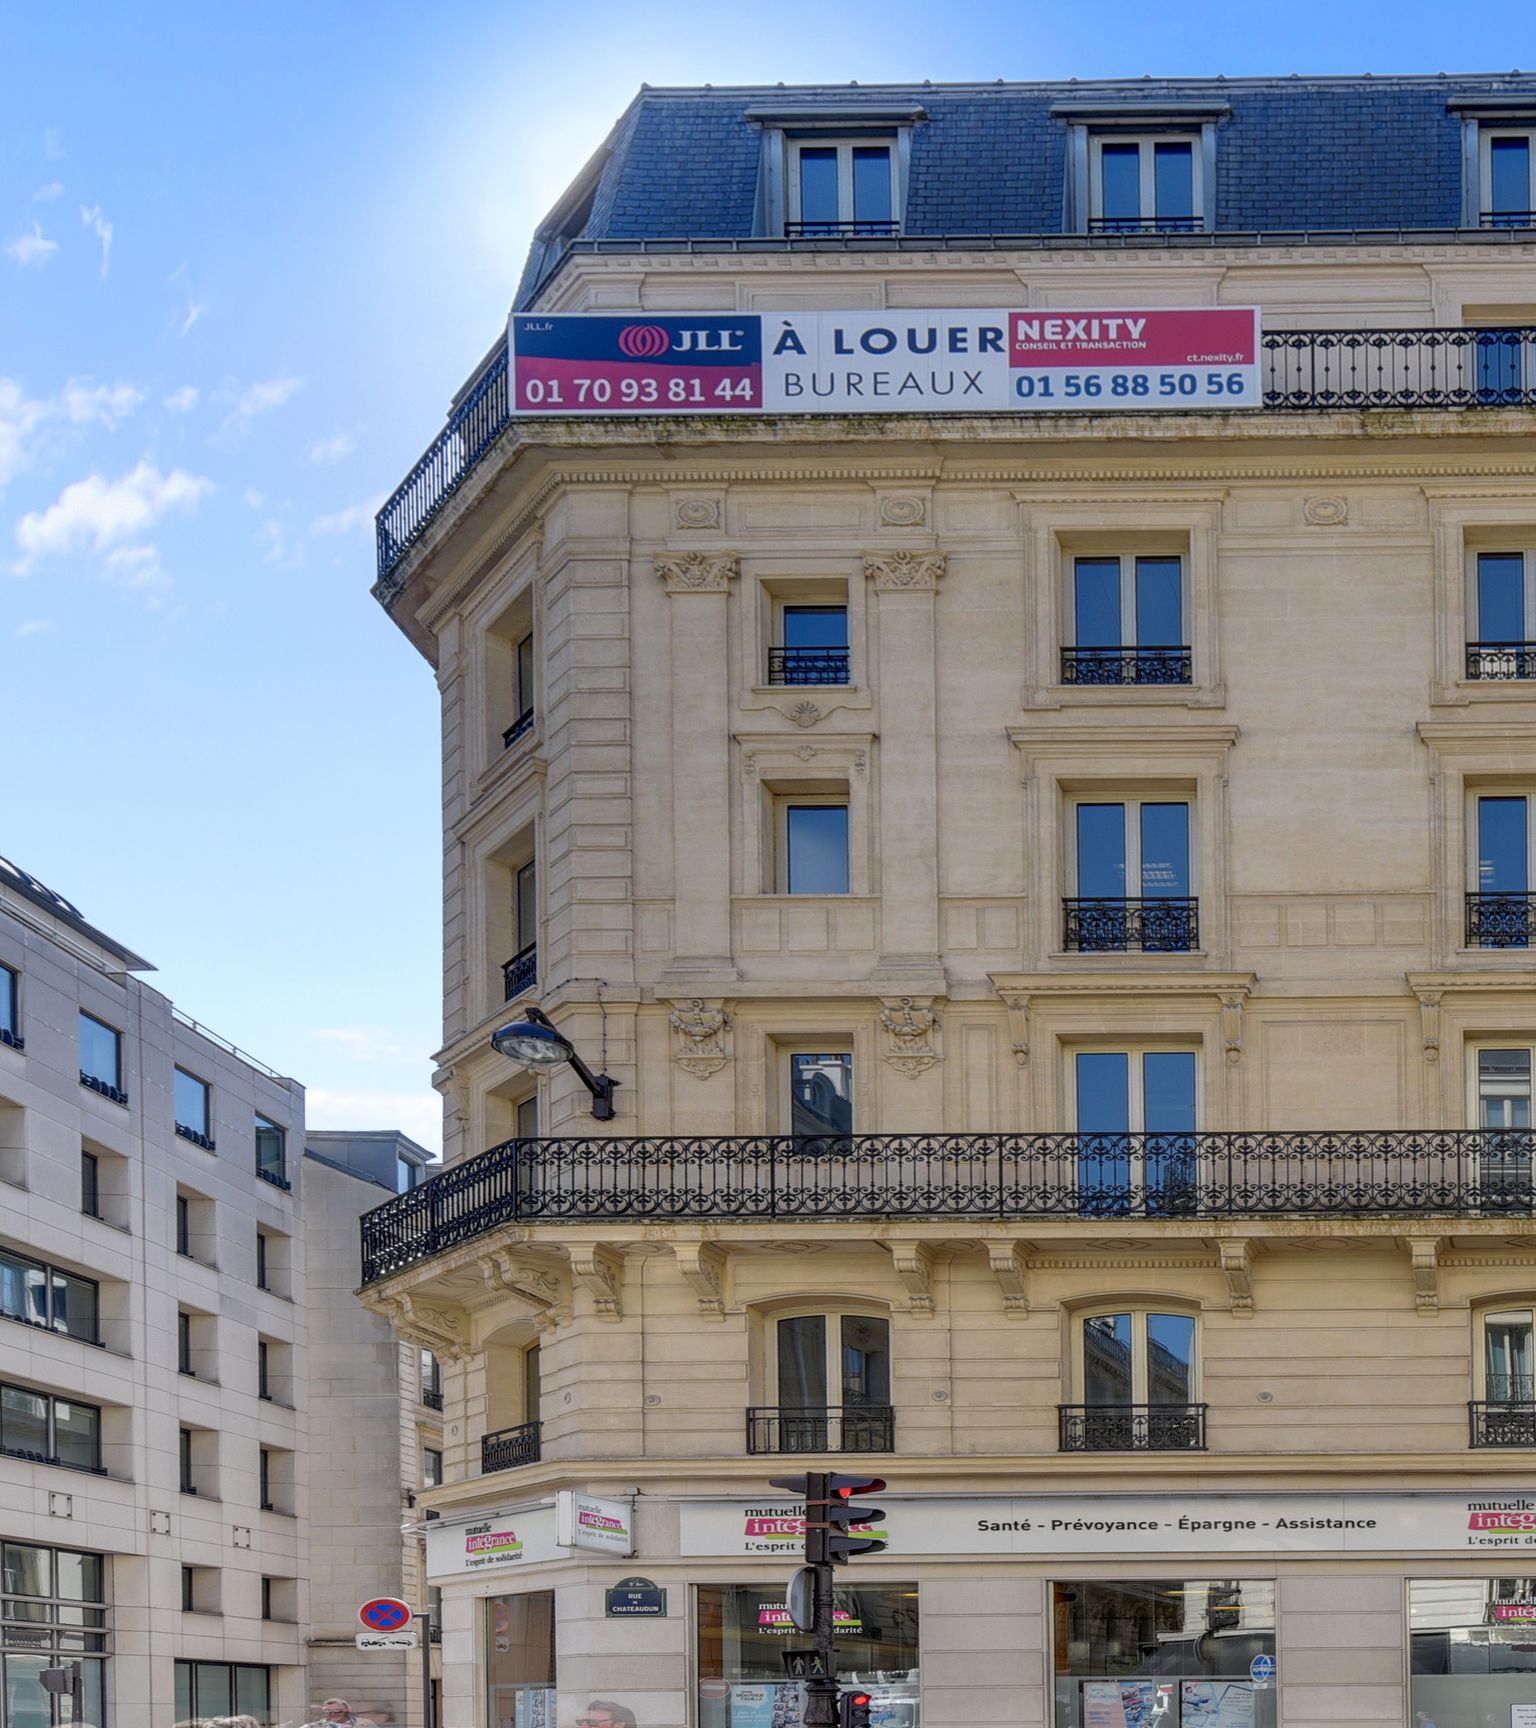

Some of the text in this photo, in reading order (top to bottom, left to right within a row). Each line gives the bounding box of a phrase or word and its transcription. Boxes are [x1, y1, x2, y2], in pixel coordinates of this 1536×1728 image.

[524, 322, 554, 331] JLL.fr
[1017, 318, 1146, 341] NEXITY
[672, 330, 742, 351] JLL
[773, 320, 1006, 355] À LOUER
[1016, 342, 1058, 350] CONSEIL
[1076, 341, 1146, 349] TRANSACTION
[1186, 352, 1244, 363] ct.nexity.fr
[525, 378, 753, 403] 01 70 93 81 44
[785, 371, 984, 396] BUREAUX
[1016, 373, 1244, 397] 01 56 88 50 56
[1468, 1500, 1535, 1511] mutuelle
[753, 1518, 872, 1537] intégce
[977, 1517, 1031, 1531] Santé
[1051, 1518, 1158, 1533] Prévoyance
[1178, 1515, 1256, 1533] Épargne
[1275, 1516, 1377, 1529] Assistance
[745, 1542, 796, 1552] L'esprit
[1468, 1536, 1519, 1546] L'esprit
[759, 1627, 796, 1636] L'esprit
